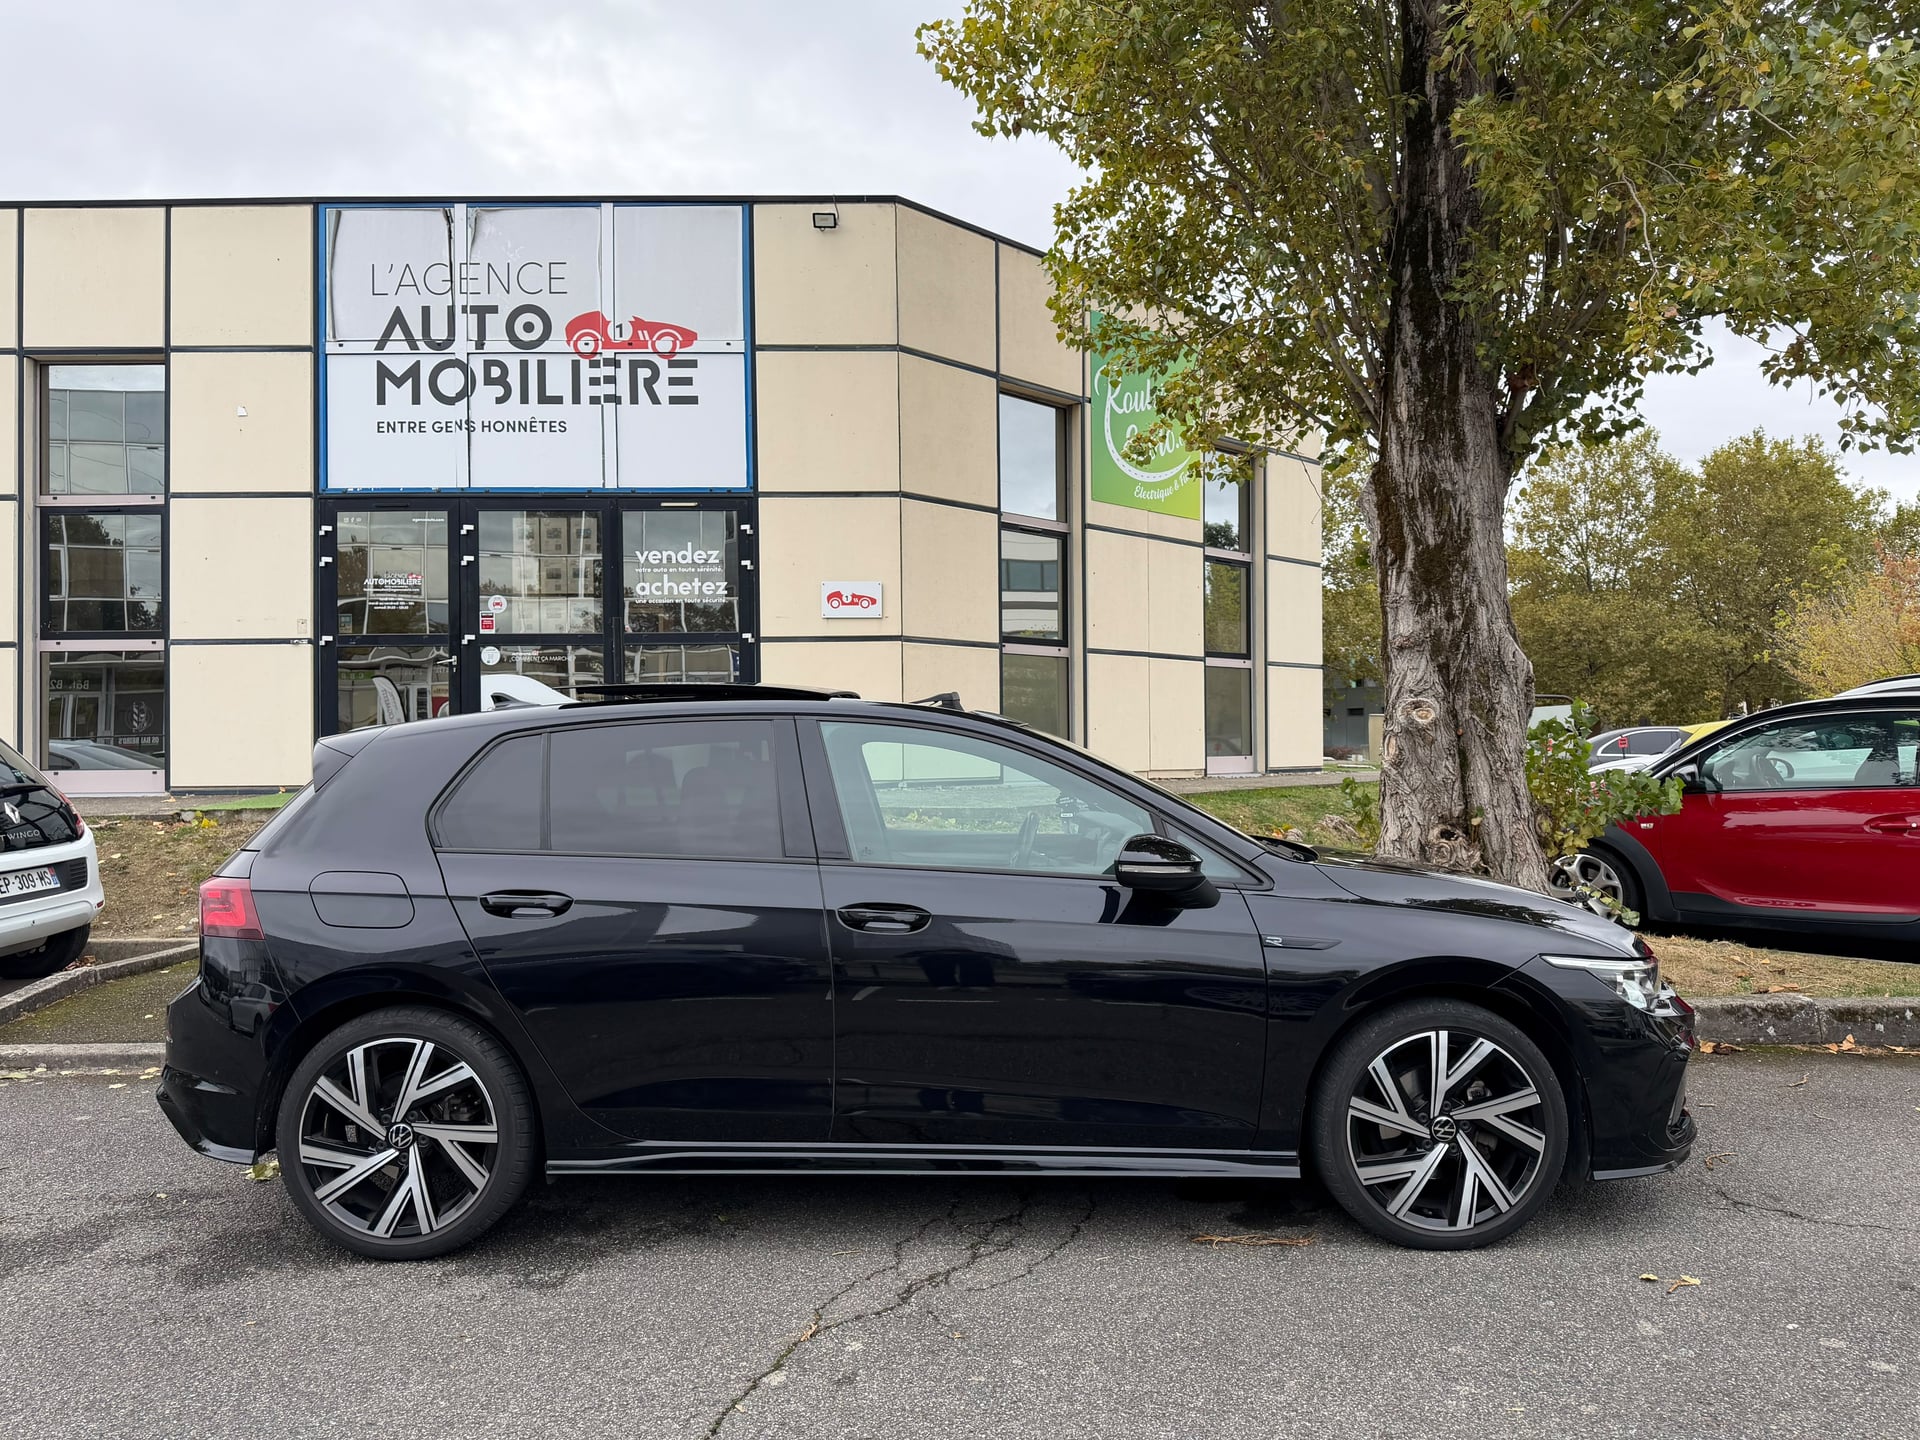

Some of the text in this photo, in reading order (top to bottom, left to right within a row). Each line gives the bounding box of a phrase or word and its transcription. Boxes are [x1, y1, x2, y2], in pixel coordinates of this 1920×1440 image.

[371, 261, 568, 297] L'AGENCE
[373, 303, 553, 351] AUTO
[376, 416, 568, 434] ENTRE GENS HONNÊTES
[1134, 482, 1173, 502] Électrique
[635, 541, 720, 564] vendez
[635, 573, 729, 596] achetez
[0, 829, 40, 841] TWINGO
